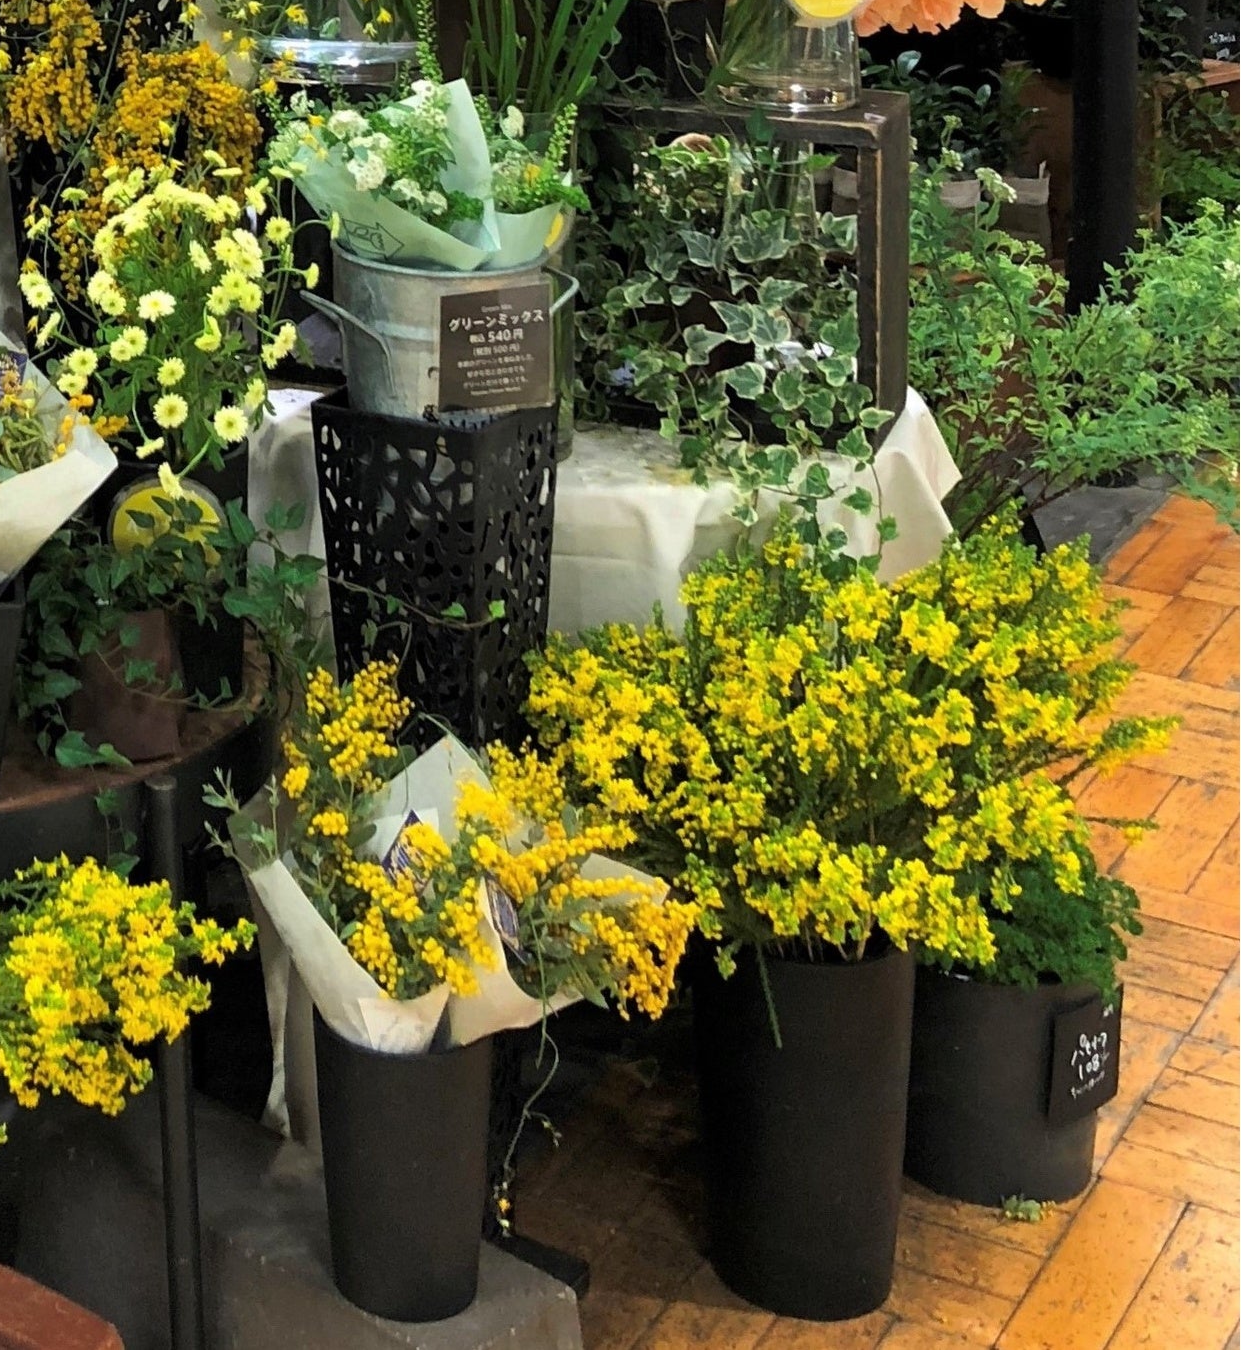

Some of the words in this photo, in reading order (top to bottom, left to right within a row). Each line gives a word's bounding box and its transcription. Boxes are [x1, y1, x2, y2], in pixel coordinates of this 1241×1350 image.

[448, 309, 545, 332] グリーンミックス
